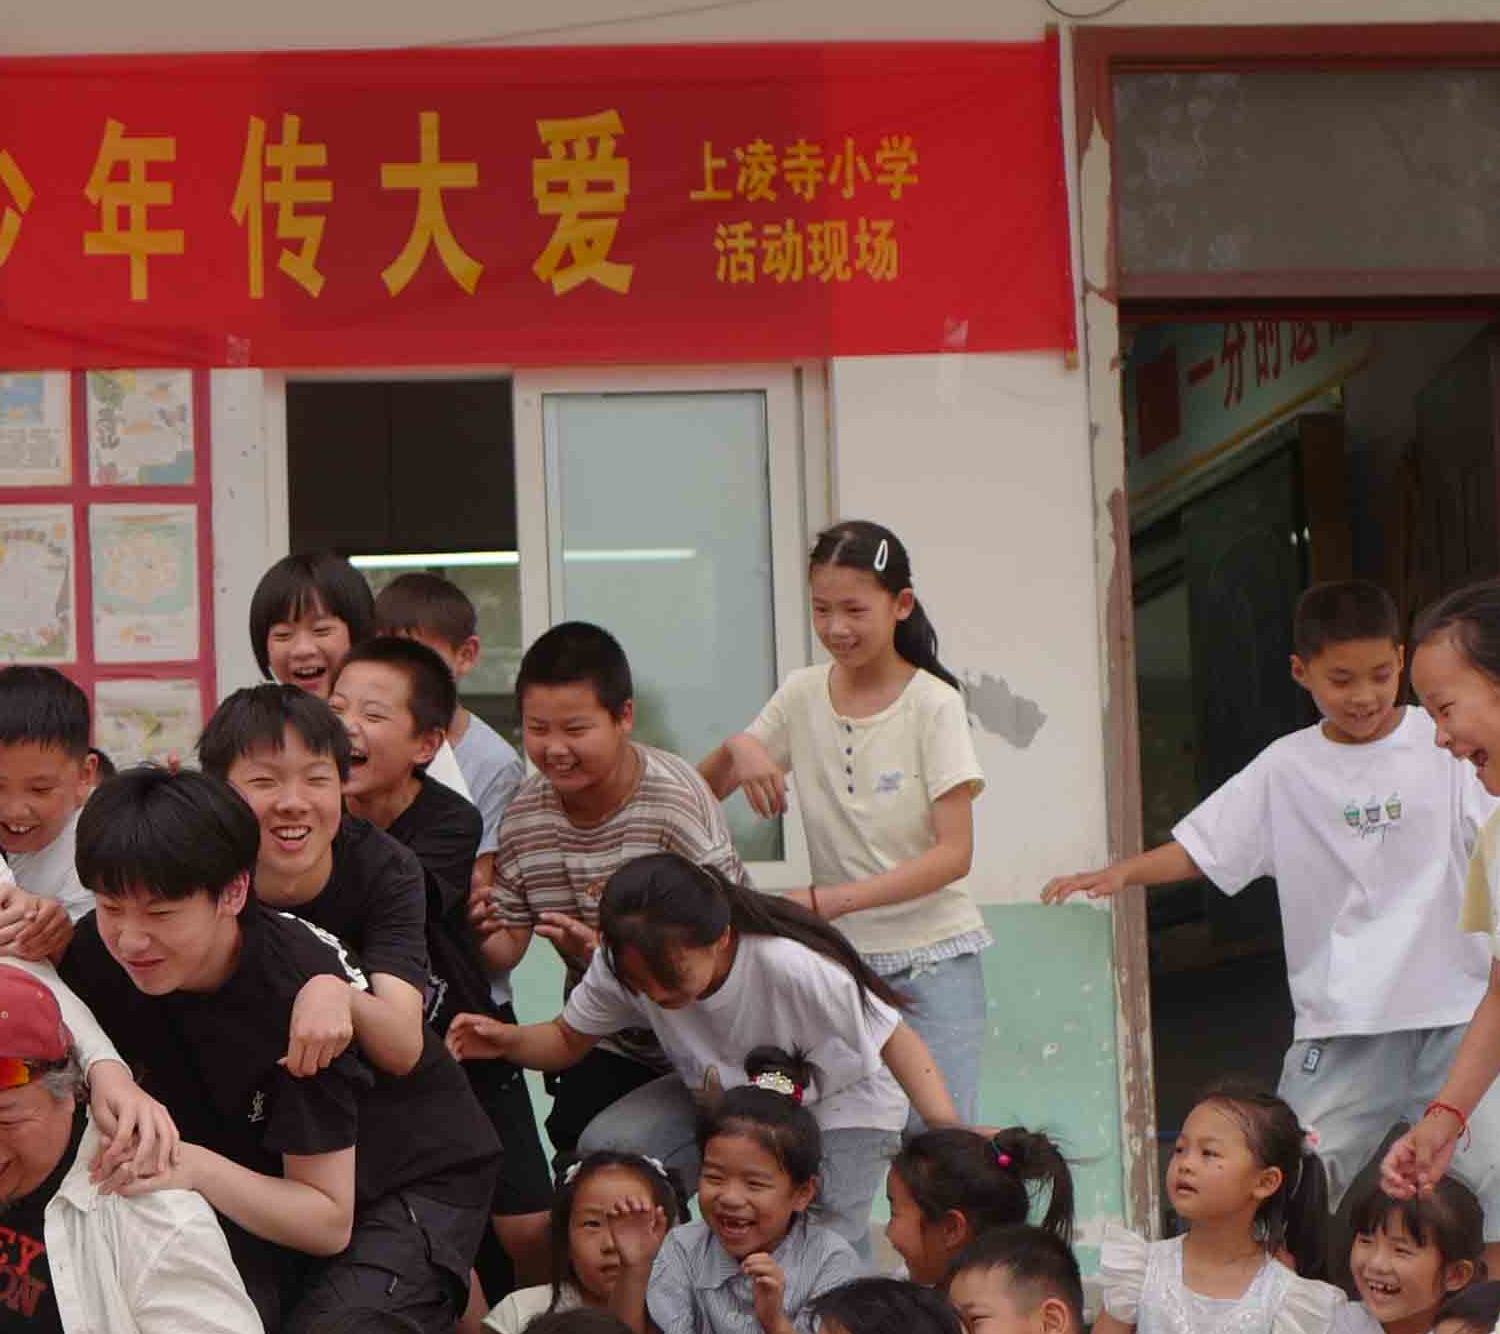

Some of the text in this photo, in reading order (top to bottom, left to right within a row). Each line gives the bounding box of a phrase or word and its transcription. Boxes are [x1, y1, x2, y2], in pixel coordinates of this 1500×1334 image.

[690, 137, 920, 203] 上凌寺小学
[712, 217, 899, 285] 活动现场
